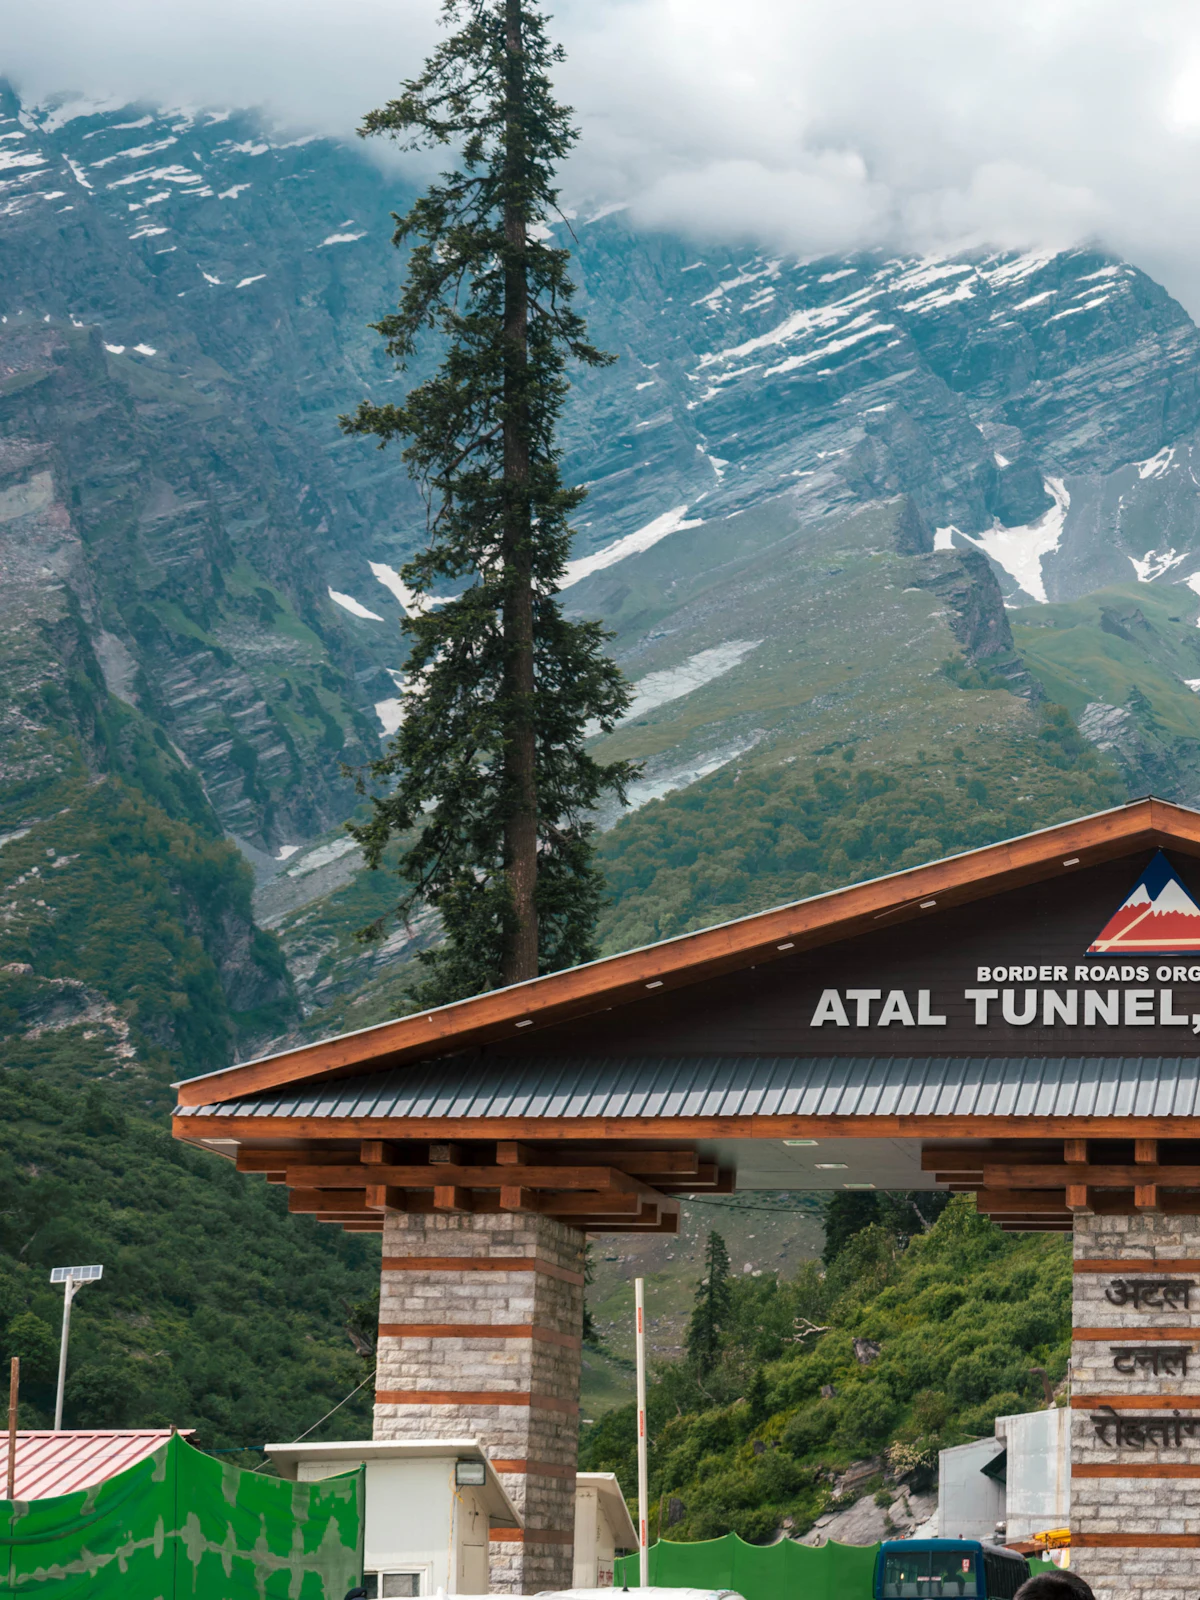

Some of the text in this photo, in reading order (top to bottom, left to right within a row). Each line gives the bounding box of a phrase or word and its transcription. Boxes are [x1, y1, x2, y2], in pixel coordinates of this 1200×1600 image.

[976, 965, 1069, 982] BORDER
[1074, 965, 1150, 982] ROADS
[809, 988, 947, 1027] ATAL
[1105, 1278, 1195, 1309] अटल
[1109, 1346, 1193, 1377] टनल
